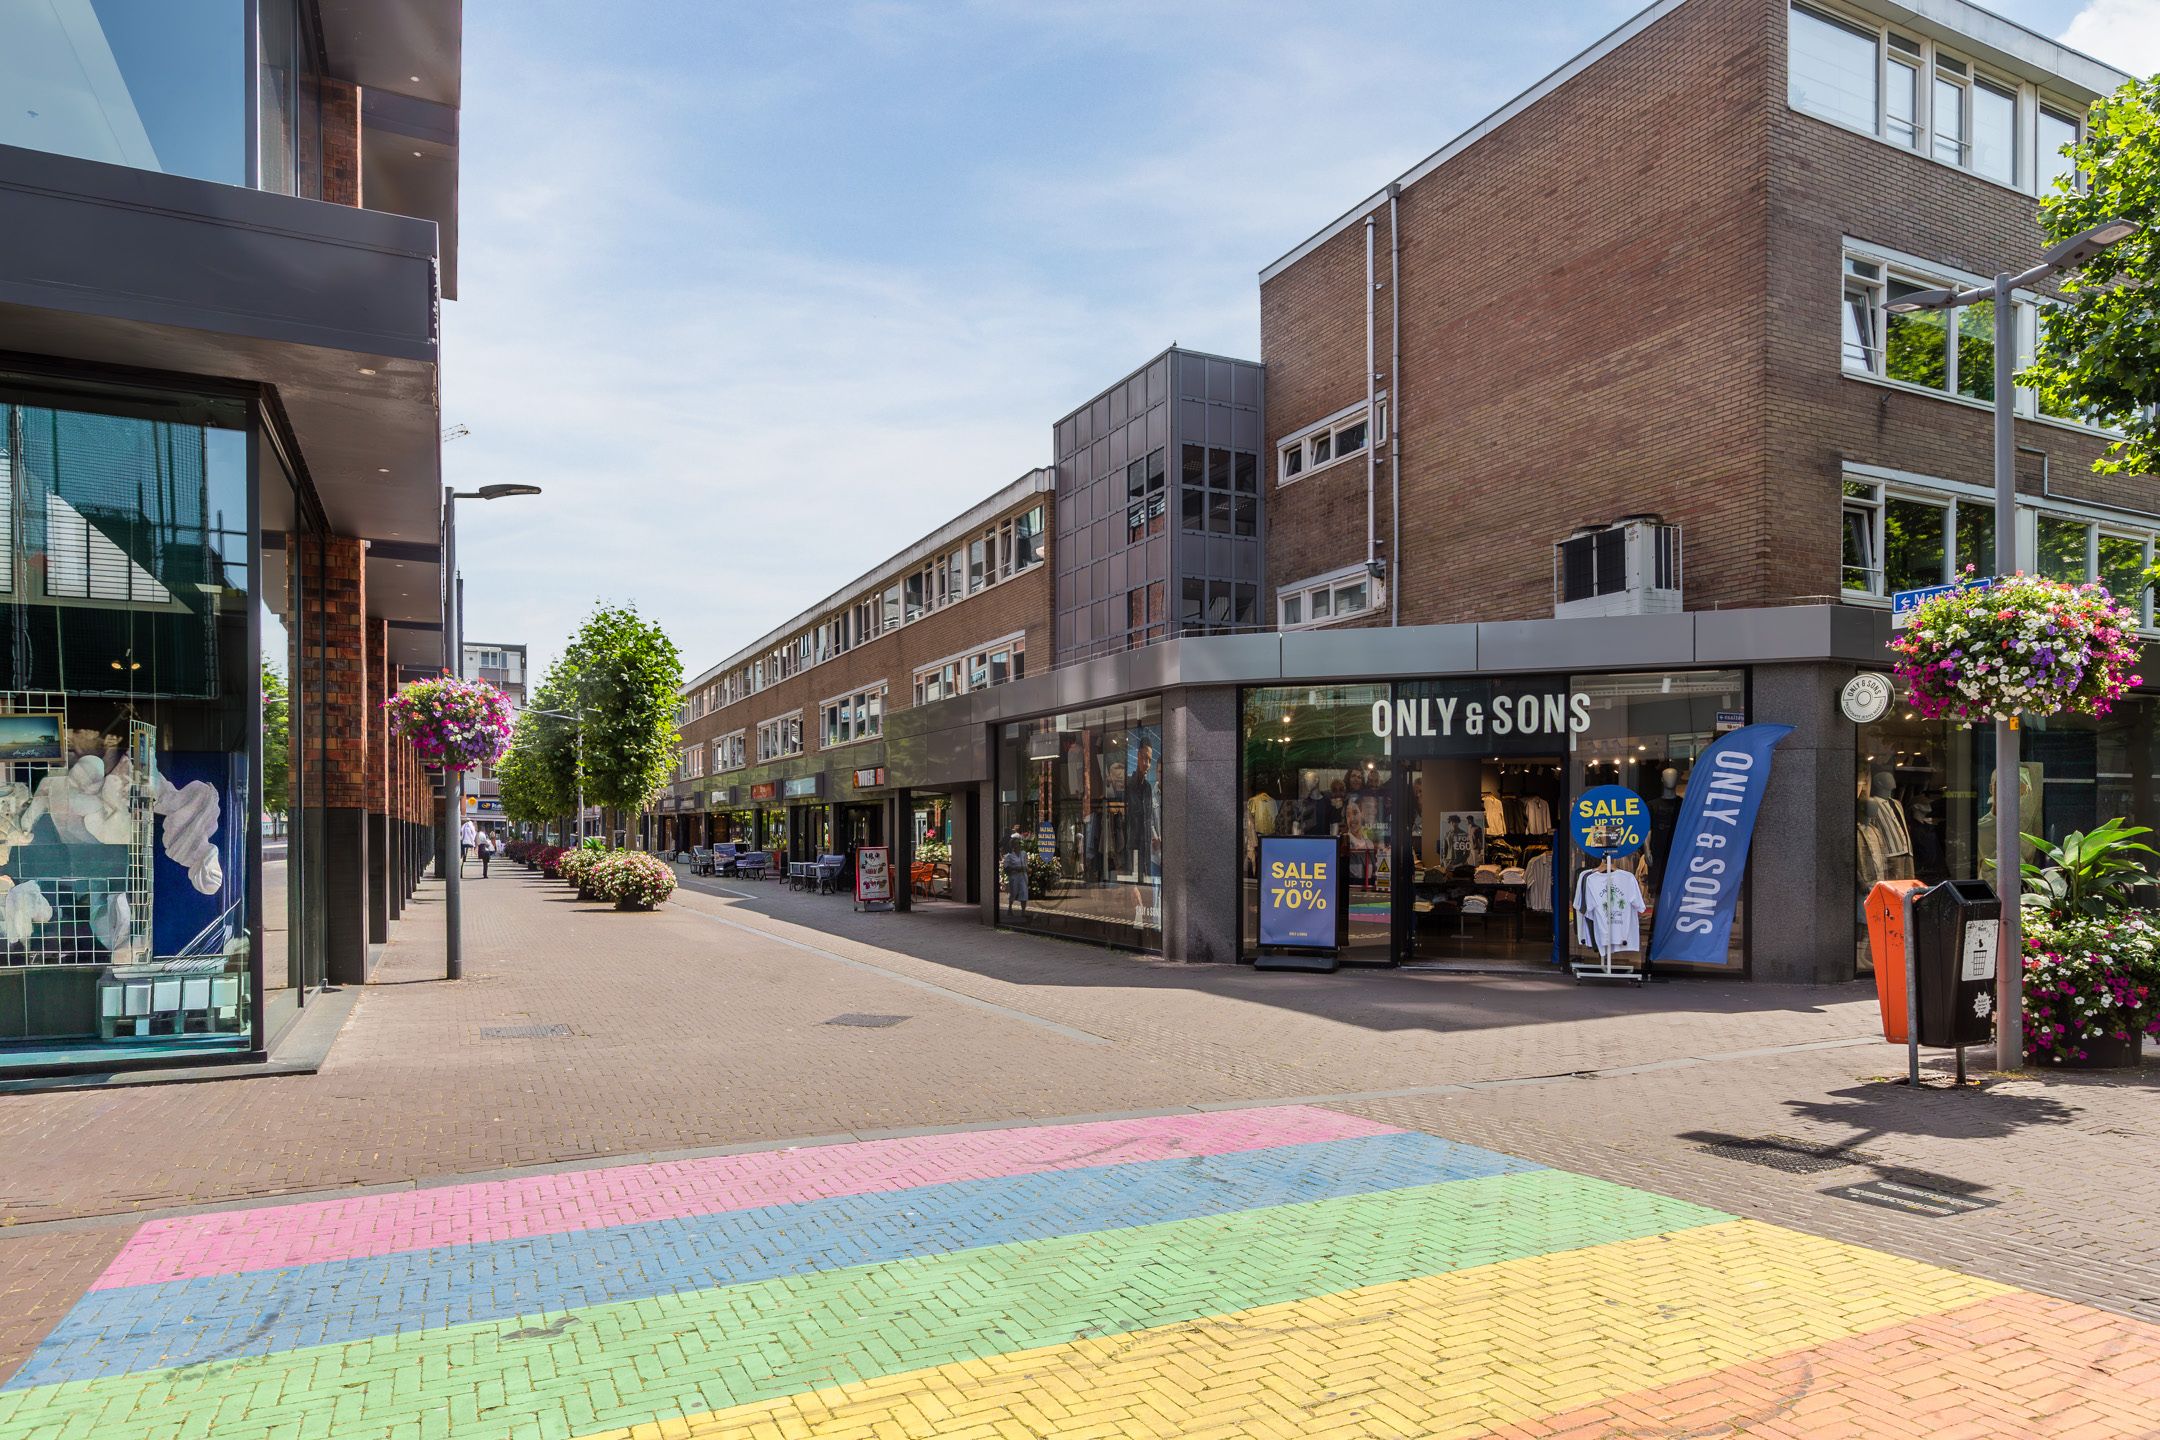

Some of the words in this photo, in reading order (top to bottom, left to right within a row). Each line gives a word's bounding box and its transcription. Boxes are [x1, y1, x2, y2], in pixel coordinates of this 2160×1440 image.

[1847, 681, 1861, 697] ONLY
[1866, 680, 1882, 695] SONS
[1372, 697, 1457, 737] ONLY
[1465, 702, 1484, 735] &
[1492, 692, 1590, 735] SONS
[1703, 750, 1754, 826] ONLY
[1579, 798, 1640, 818] SALE
[1594, 818, 1608, 826] UP
[1610, 817, 1624, 825] TO
[1582, 824, 1639, 846] 7%
[1695, 832, 1726, 849] &
[1271, 861, 1327, 880] SALE
[1284, 880, 1298, 888] UP
[1300, 880, 1313, 888] TO
[1271, 888, 1327, 910] 70%
[1675, 856, 1726, 935] SONS
